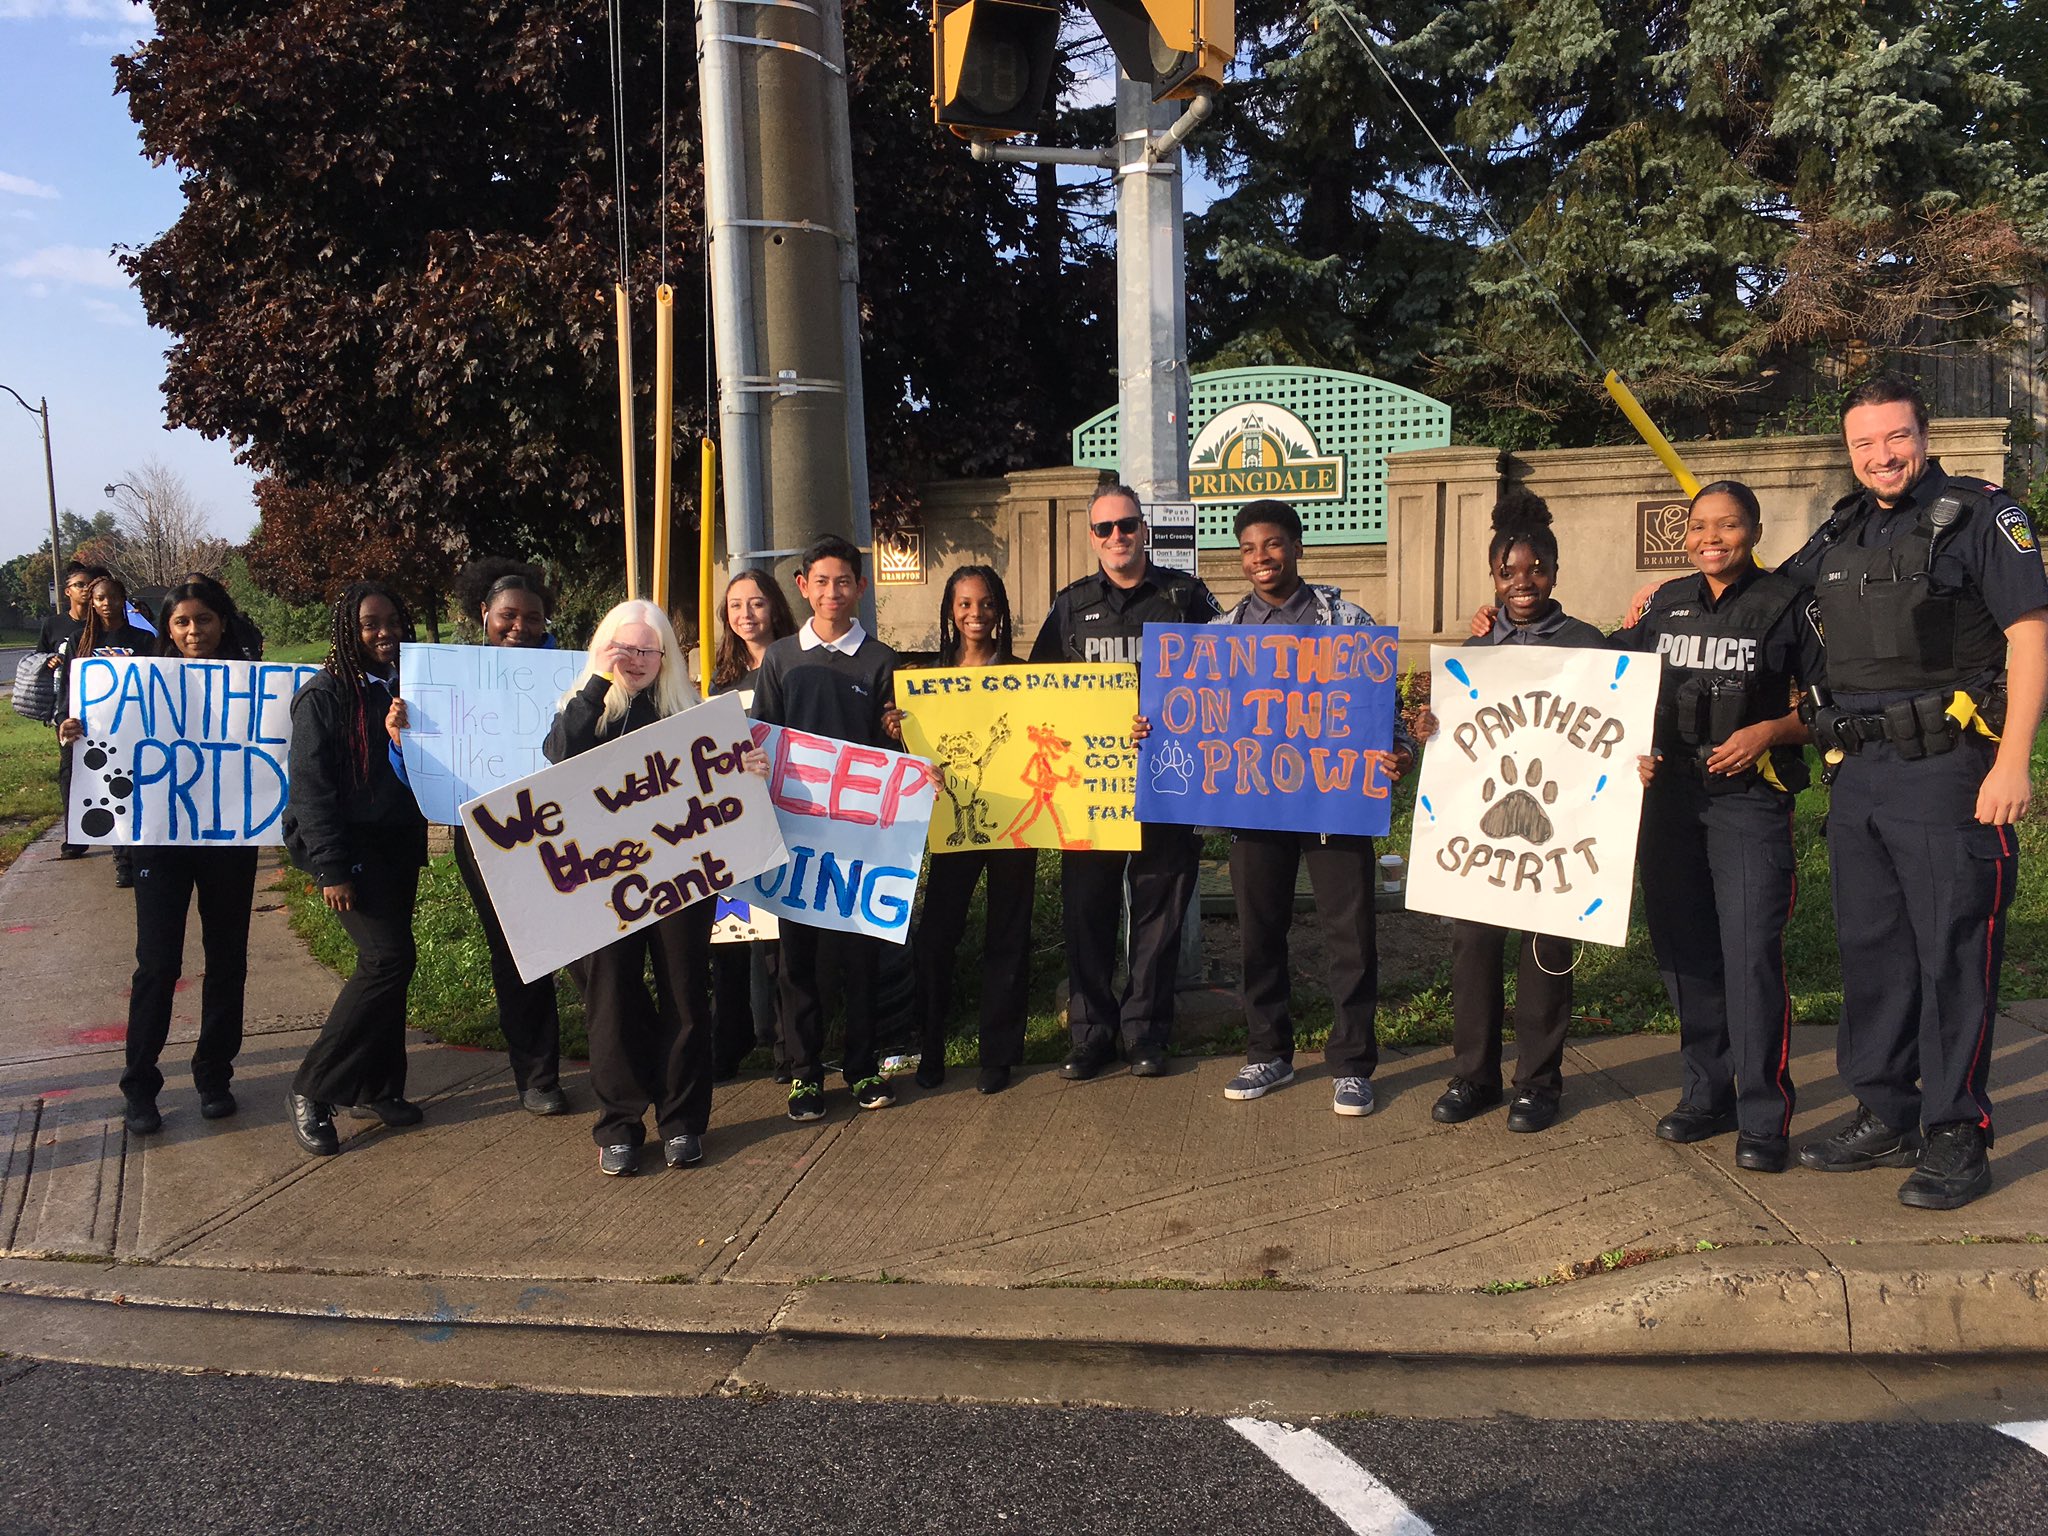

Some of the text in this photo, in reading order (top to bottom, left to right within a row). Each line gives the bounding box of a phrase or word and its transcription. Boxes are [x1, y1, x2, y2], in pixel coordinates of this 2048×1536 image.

[1189, 469, 1333, 495] PRINGDALE
[1169, 533, 1193, 541] Crossing
[1643, 556, 1692, 566] BRAMPT
[881, 572, 920, 581] BRAMPTON
[478, 647, 535, 692] like
[553, 651, 588, 692] d
[1154, 631, 1397, 683] PANTHERS
[1656, 632, 1757, 671] POLICE
[906, 675, 972, 696] LETS
[982, 674, 1021, 692] GO
[450, 687, 502, 737] like
[512, 692, 557, 736] Di
[1162, 686, 1351, 739] ON THE
[1453, 690, 1625, 763] PANTHER
[452, 733, 507, 779] like
[1083, 735, 1135, 750] YOU
[1085, 752, 1137, 769] GOT
[132, 738, 290, 841] PRID
[471, 788, 565, 850] We
[593, 750, 682, 814] walk
[690, 735, 756, 795] for
[751, 722, 930, 829] EEP
[1198, 737, 1388, 799] PROWL
[538, 795, 744, 893] those who
[1436, 836, 1600, 894] SPIRIT
[740, 845, 917, 929] OING
